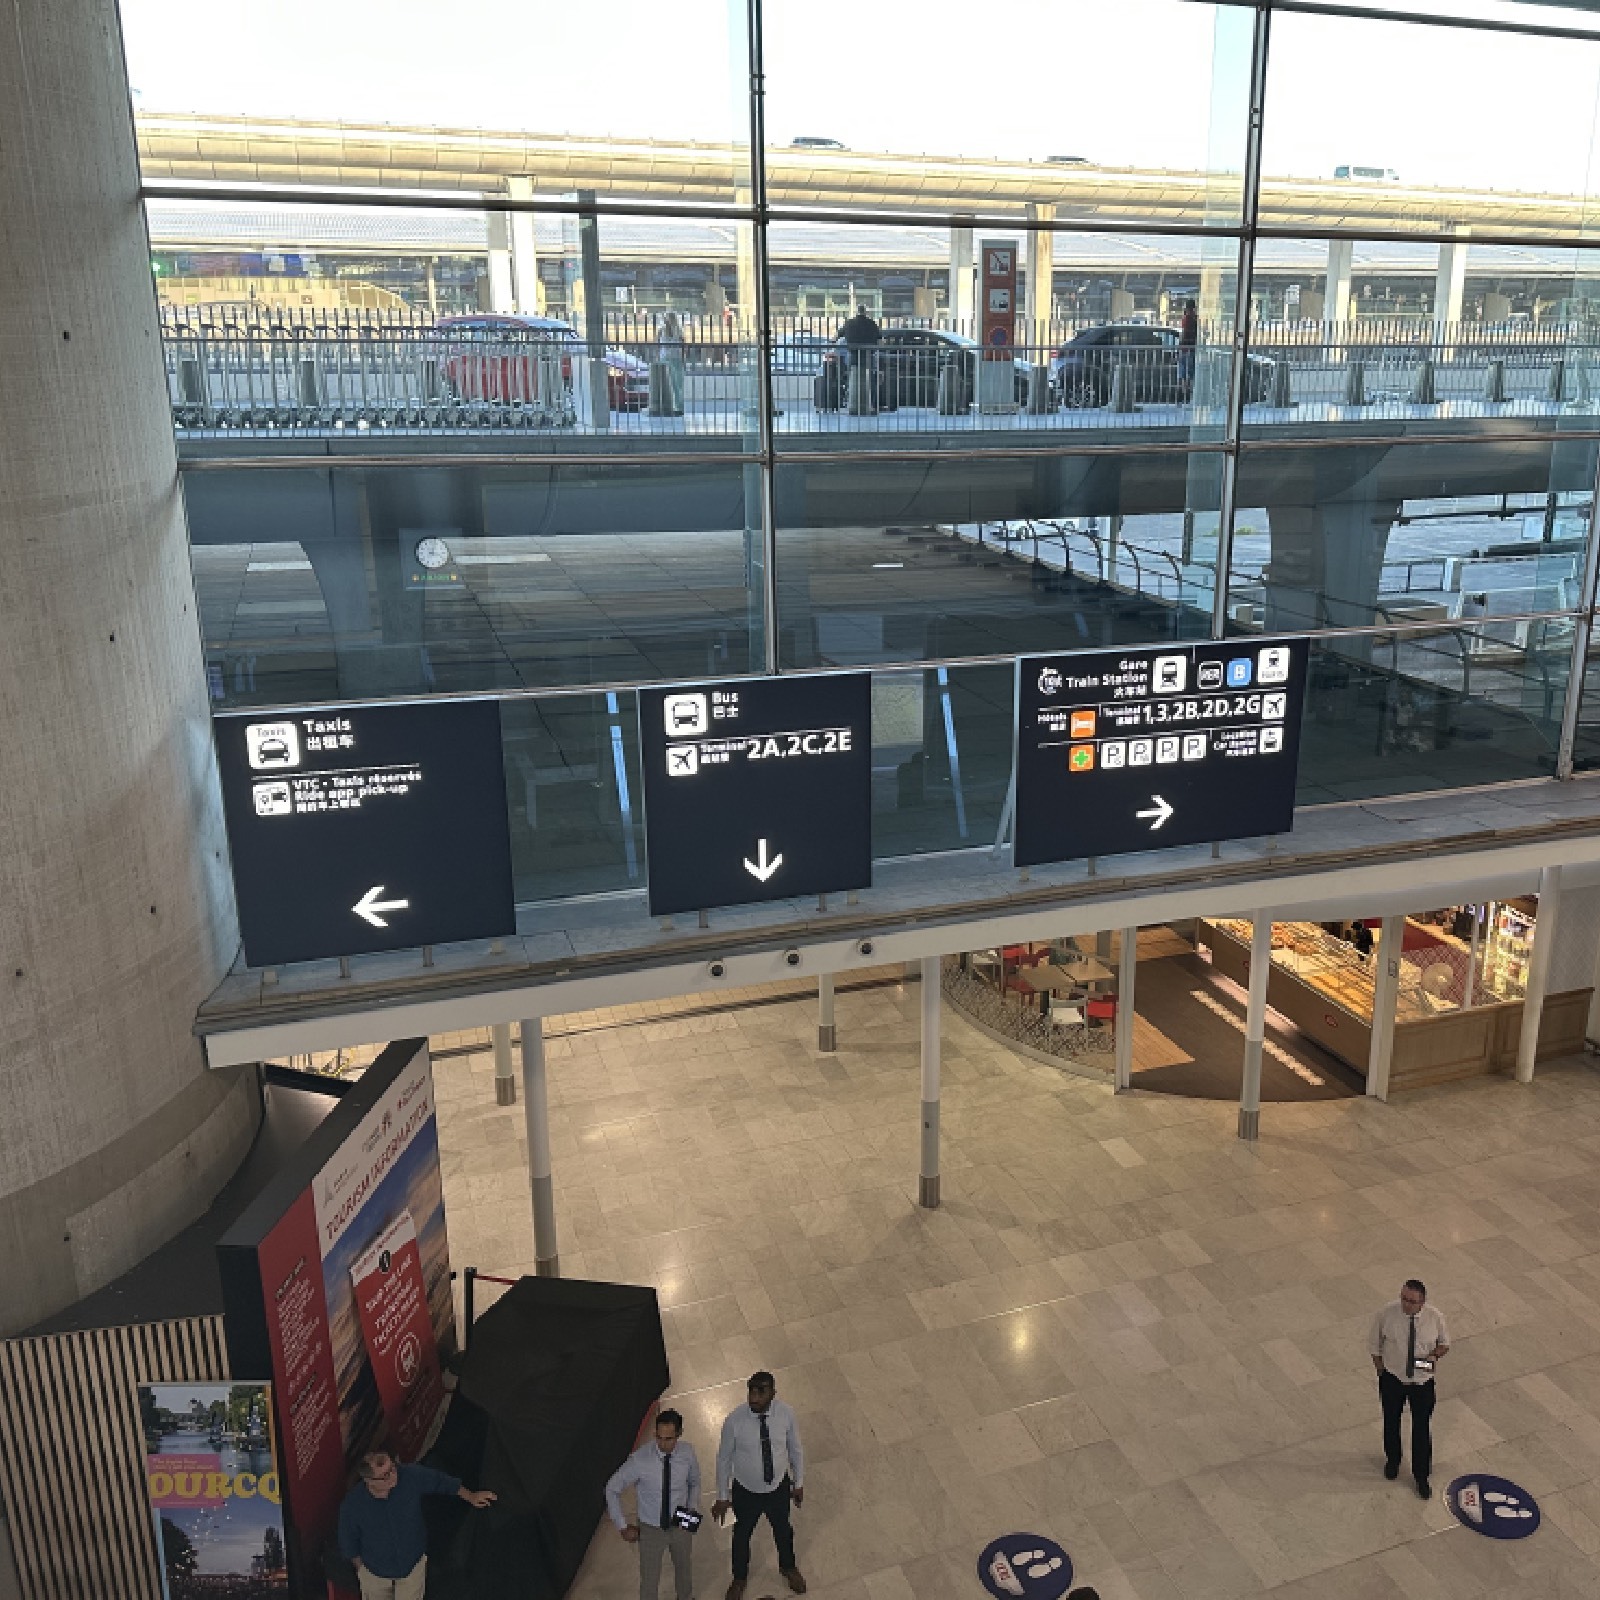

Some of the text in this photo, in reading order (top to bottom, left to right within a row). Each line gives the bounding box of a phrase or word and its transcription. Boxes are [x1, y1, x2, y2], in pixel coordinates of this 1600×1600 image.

[1119, 660, 1148, 671] Gare
[1066, 676, 1098, 688] Train
[1102, 672, 1148, 686] Station
[712, 691, 739, 705] Bus
[302, 716, 352, 733] Taxis
[747, 732, 852, 758] 2A,2C,2E
[292, 777, 319, 790] VTC
[331, 775, 364, 787] Taxis
[326, 1173, 370, 1240] TOURISM
[371, 1096, 428, 1182] INFORMATION
